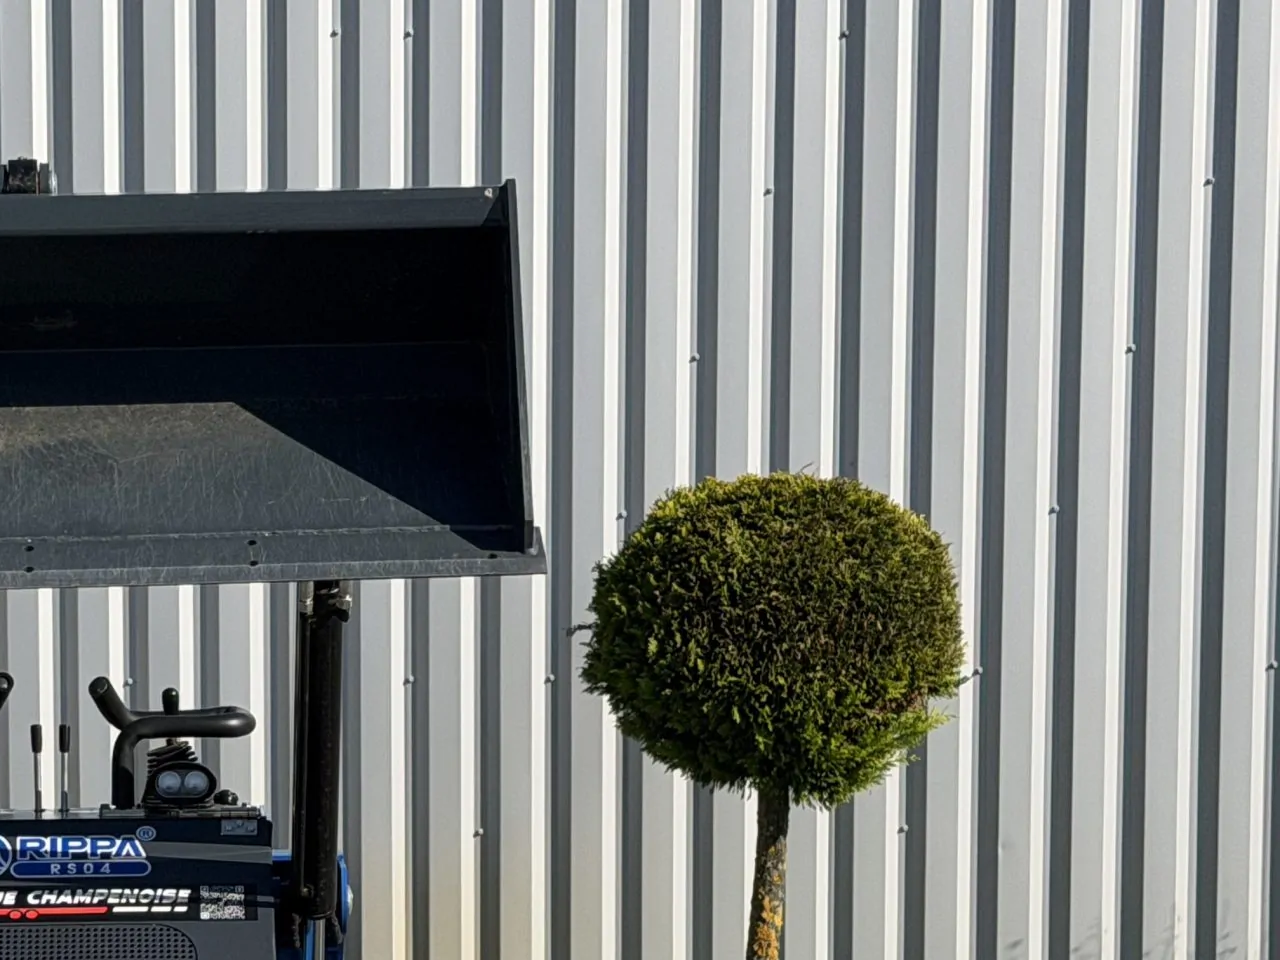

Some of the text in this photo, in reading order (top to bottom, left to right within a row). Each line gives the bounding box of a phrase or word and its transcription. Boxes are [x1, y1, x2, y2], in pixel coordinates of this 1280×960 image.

[16, 836, 147, 860] RIPPA
[50, 863, 111, 875] RS04
[27, 888, 191, 905] CHAMPENOISE
